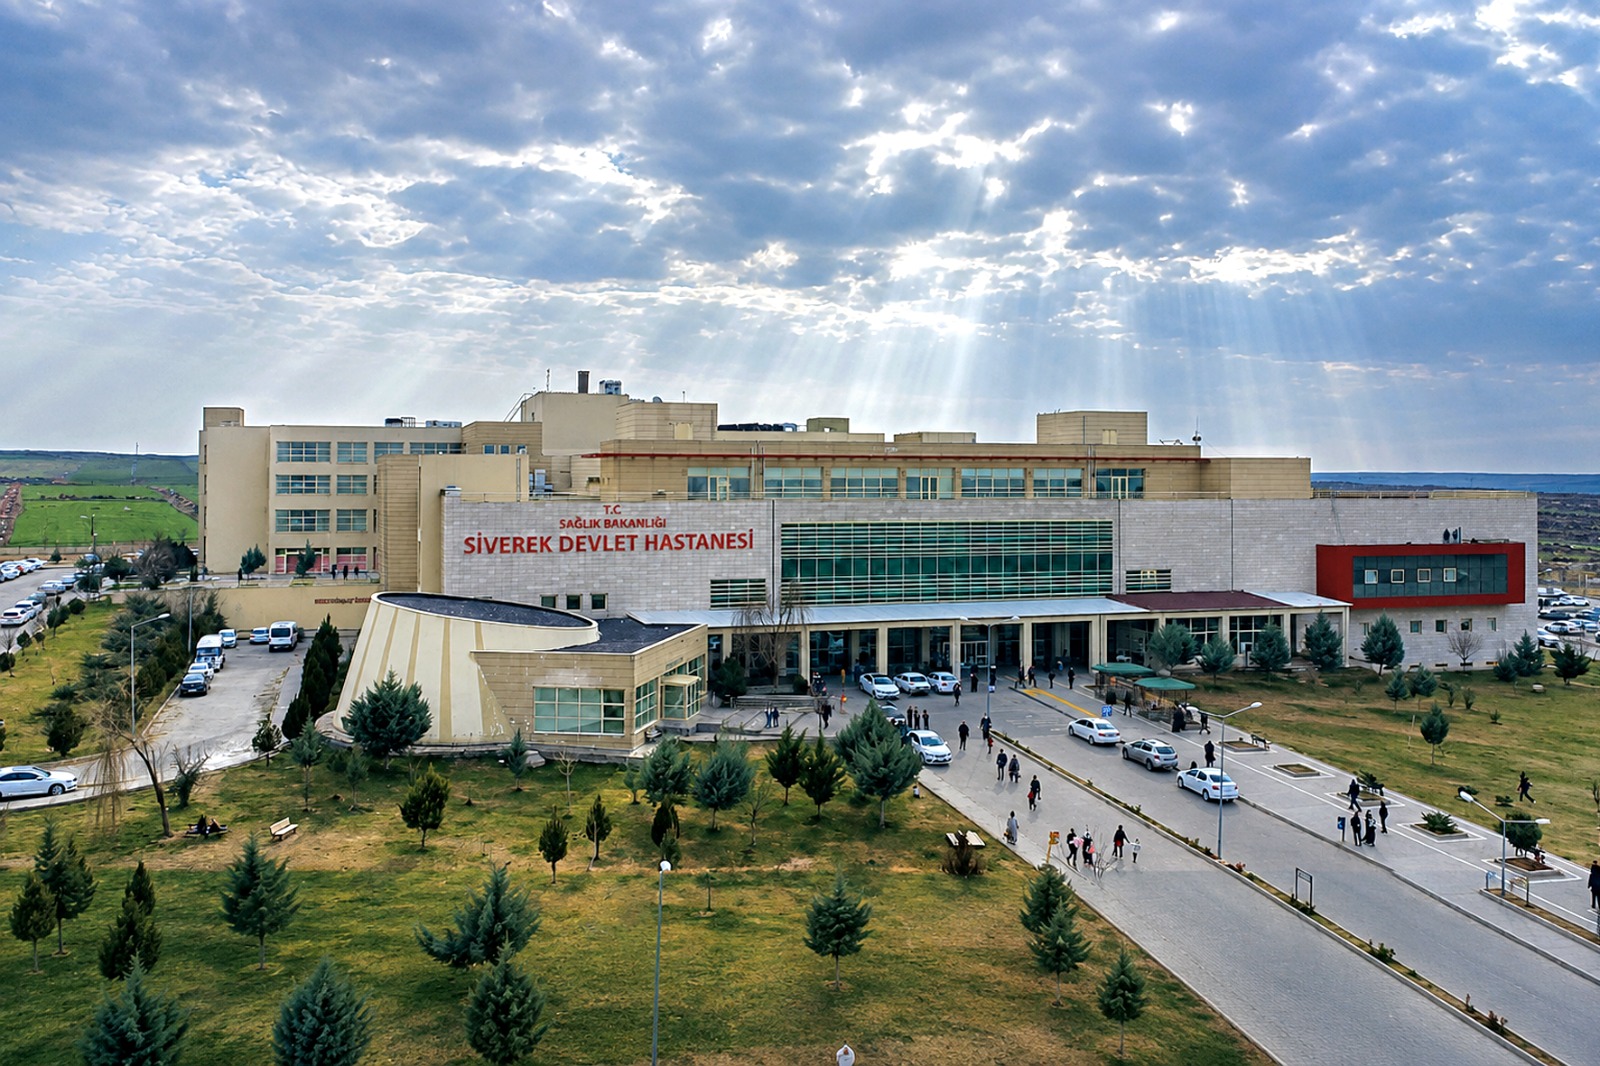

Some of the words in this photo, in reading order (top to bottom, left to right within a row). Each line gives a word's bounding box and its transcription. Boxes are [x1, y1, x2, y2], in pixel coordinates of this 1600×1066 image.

[603, 504, 622, 515] T.C
[559, 516, 601, 529] SAĞLIK
[604, 515, 667, 528] BAKANLIĞI
[463, 531, 553, 555] SİVEREK
[559, 533, 636, 552] DEVLET
[644, 528, 754, 550] HASTANESİ
